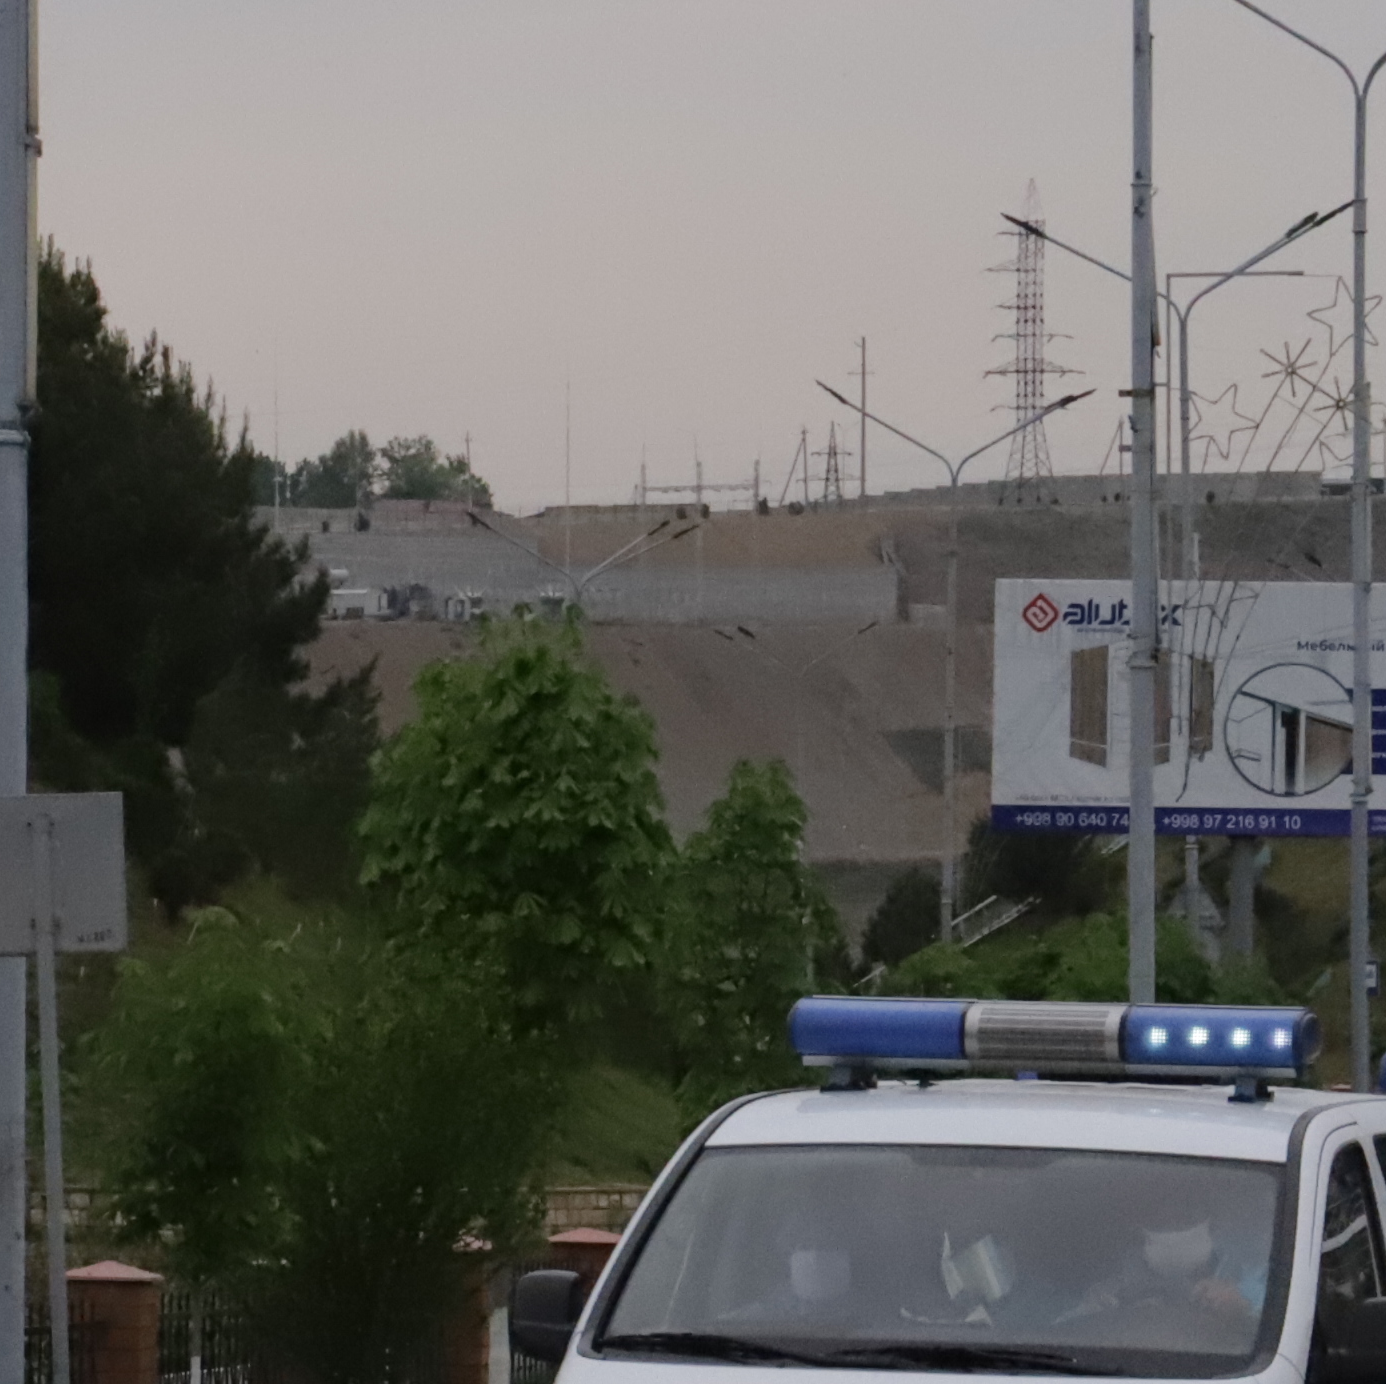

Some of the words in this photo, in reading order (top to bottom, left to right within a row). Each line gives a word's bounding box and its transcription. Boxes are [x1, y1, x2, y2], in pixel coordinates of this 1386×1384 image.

[1063, 597, 1181, 626] alutx
[1015, 812, 1051, 826] +998
[1055, 812, 1075, 826] 90
[1078, 812, 1107, 827] 640
[1163, 814, 1200, 828] +998
[1203, 814, 1222, 828] 97
[1226, 815, 1255, 829] 216
[1258, 815, 1277, 829] 91
[1283, 815, 1302, 829] 10
